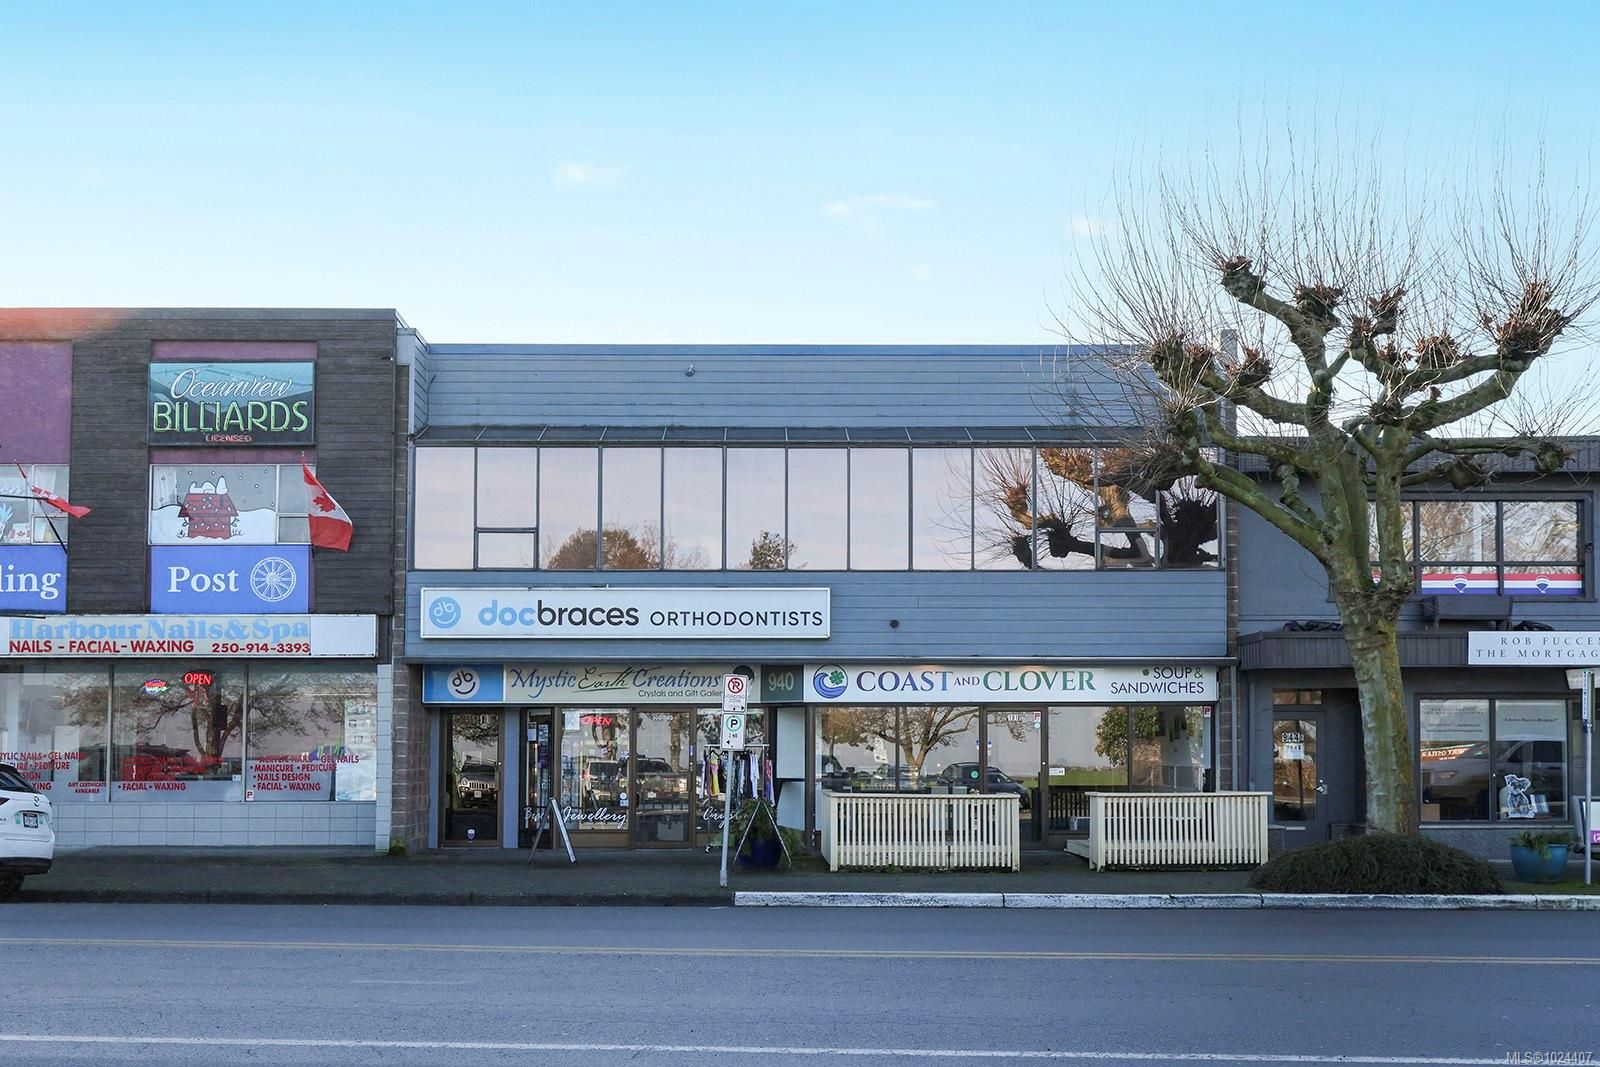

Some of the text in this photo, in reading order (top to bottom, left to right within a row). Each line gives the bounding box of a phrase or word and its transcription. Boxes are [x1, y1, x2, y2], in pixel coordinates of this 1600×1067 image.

[171, 368, 293, 399] Oceanview
[153, 401, 309, 433] BILLIARDS
[205, 435, 253, 443] LICENSED
[167, 566, 240, 593] Post
[478, 599, 823, 627] docbraces ORTHODONTISTS
[9, 618, 143, 640] Harbour
[9, 641, 53, 653] NAILS
[211, 643, 311, 653] 250-914-3393
[1500, 637, 1600, 646] ROB FUCCE
[1475, 649, 1506, 658] THE
[184, 672, 212, 685] OPEN
[510, 666, 721, 699] Mystic Earth Creations
[768, 671, 795, 692] 940
[856, 670, 1097, 692] COAST AND CLOVER
[1109, 681, 1205, 694] SANDWICHES
[638, 690, 666, 698] Crystals
[580, 715, 613, 726] OPEN
[336, 755, 360, 764] NAILS
[254, 764, 294, 773] MANICURE
[257, 773, 311, 781] NAILS DESIGN
[122, 782, 186, 791] FACIAL WAXING
[257, 782, 321, 791] FACIAL WAXING
[562, 806, 628, 829] Jewellery
